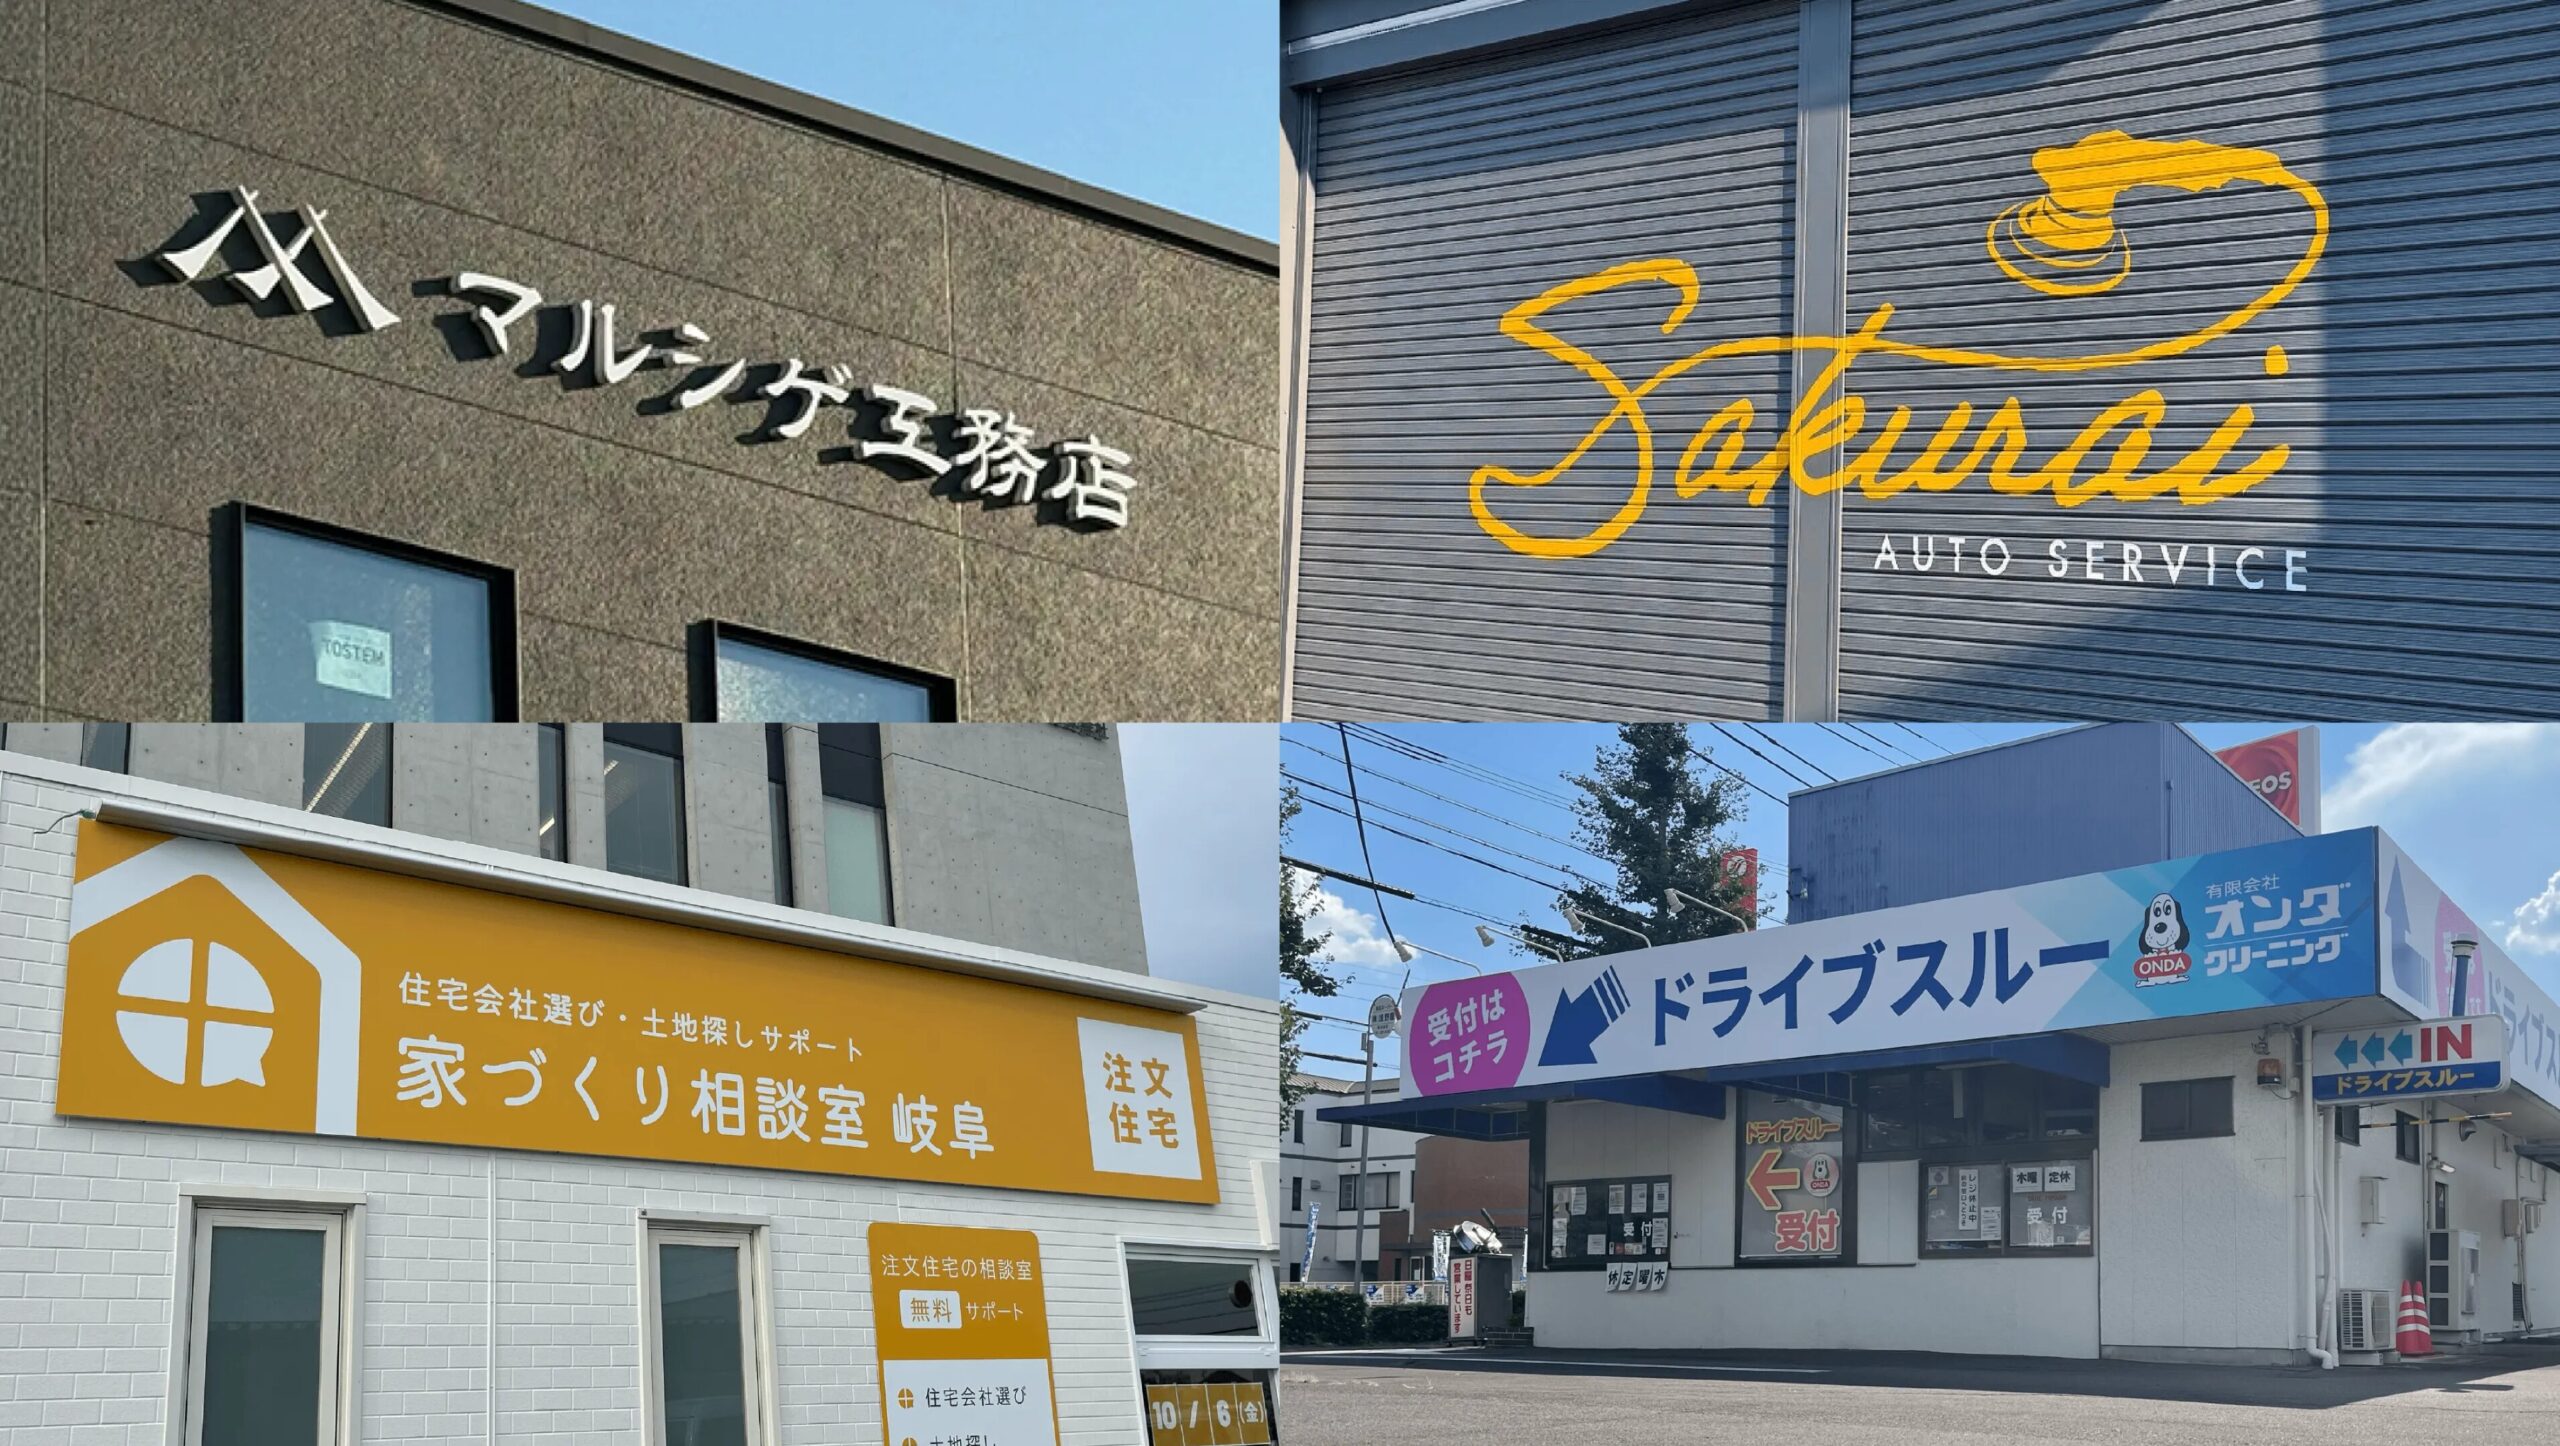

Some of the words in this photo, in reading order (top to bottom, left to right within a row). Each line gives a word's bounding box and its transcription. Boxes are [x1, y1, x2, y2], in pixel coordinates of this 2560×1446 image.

[453, 271, 1138, 529] マルシゲ工務店
[1468, 258, 2292, 559] Sakurai
[1874, 534, 2012, 577] AUTO
[2048, 537, 2311, 593] SERVICE
[2205, 873, 2281, 900] 有限会社
[2204, 882, 2352, 940] オンダ
[2139, 957, 2187, 976] ONDA
[2203, 932, 2350, 977] クリーニング
[1653, 926, 2110, 1047] ドライブスルー
[1427, 988, 1506, 1047] 受付は
[1433, 1029, 1509, 1083] コチラ
[2419, 1023, 2473, 1064] IN
[1102, 1051, 1172, 1098] 注文
[2336, 1070, 2476, 1095] ドライブスルー
[396, 1034, 869, 1149] 家づくり相談室
[892, 1092, 994, 1160] 岐阜
[1108, 1102, 1180, 1149] 住宅
[1746, 1116, 1841, 1145] ドライブスルー
[1623, 1221, 1652, 1237] 受付
[1776, 1208, 1840, 1252] 受付
[2026, 1206, 2068, 1226] 受付
[881, 1254, 1034, 1281] 注文住宅の相談室
[910, 1297, 953, 1324] 無料
[964, 1301, 1025, 1322] サポート
[925, 1385, 1027, 1408] 住宅会社選び
